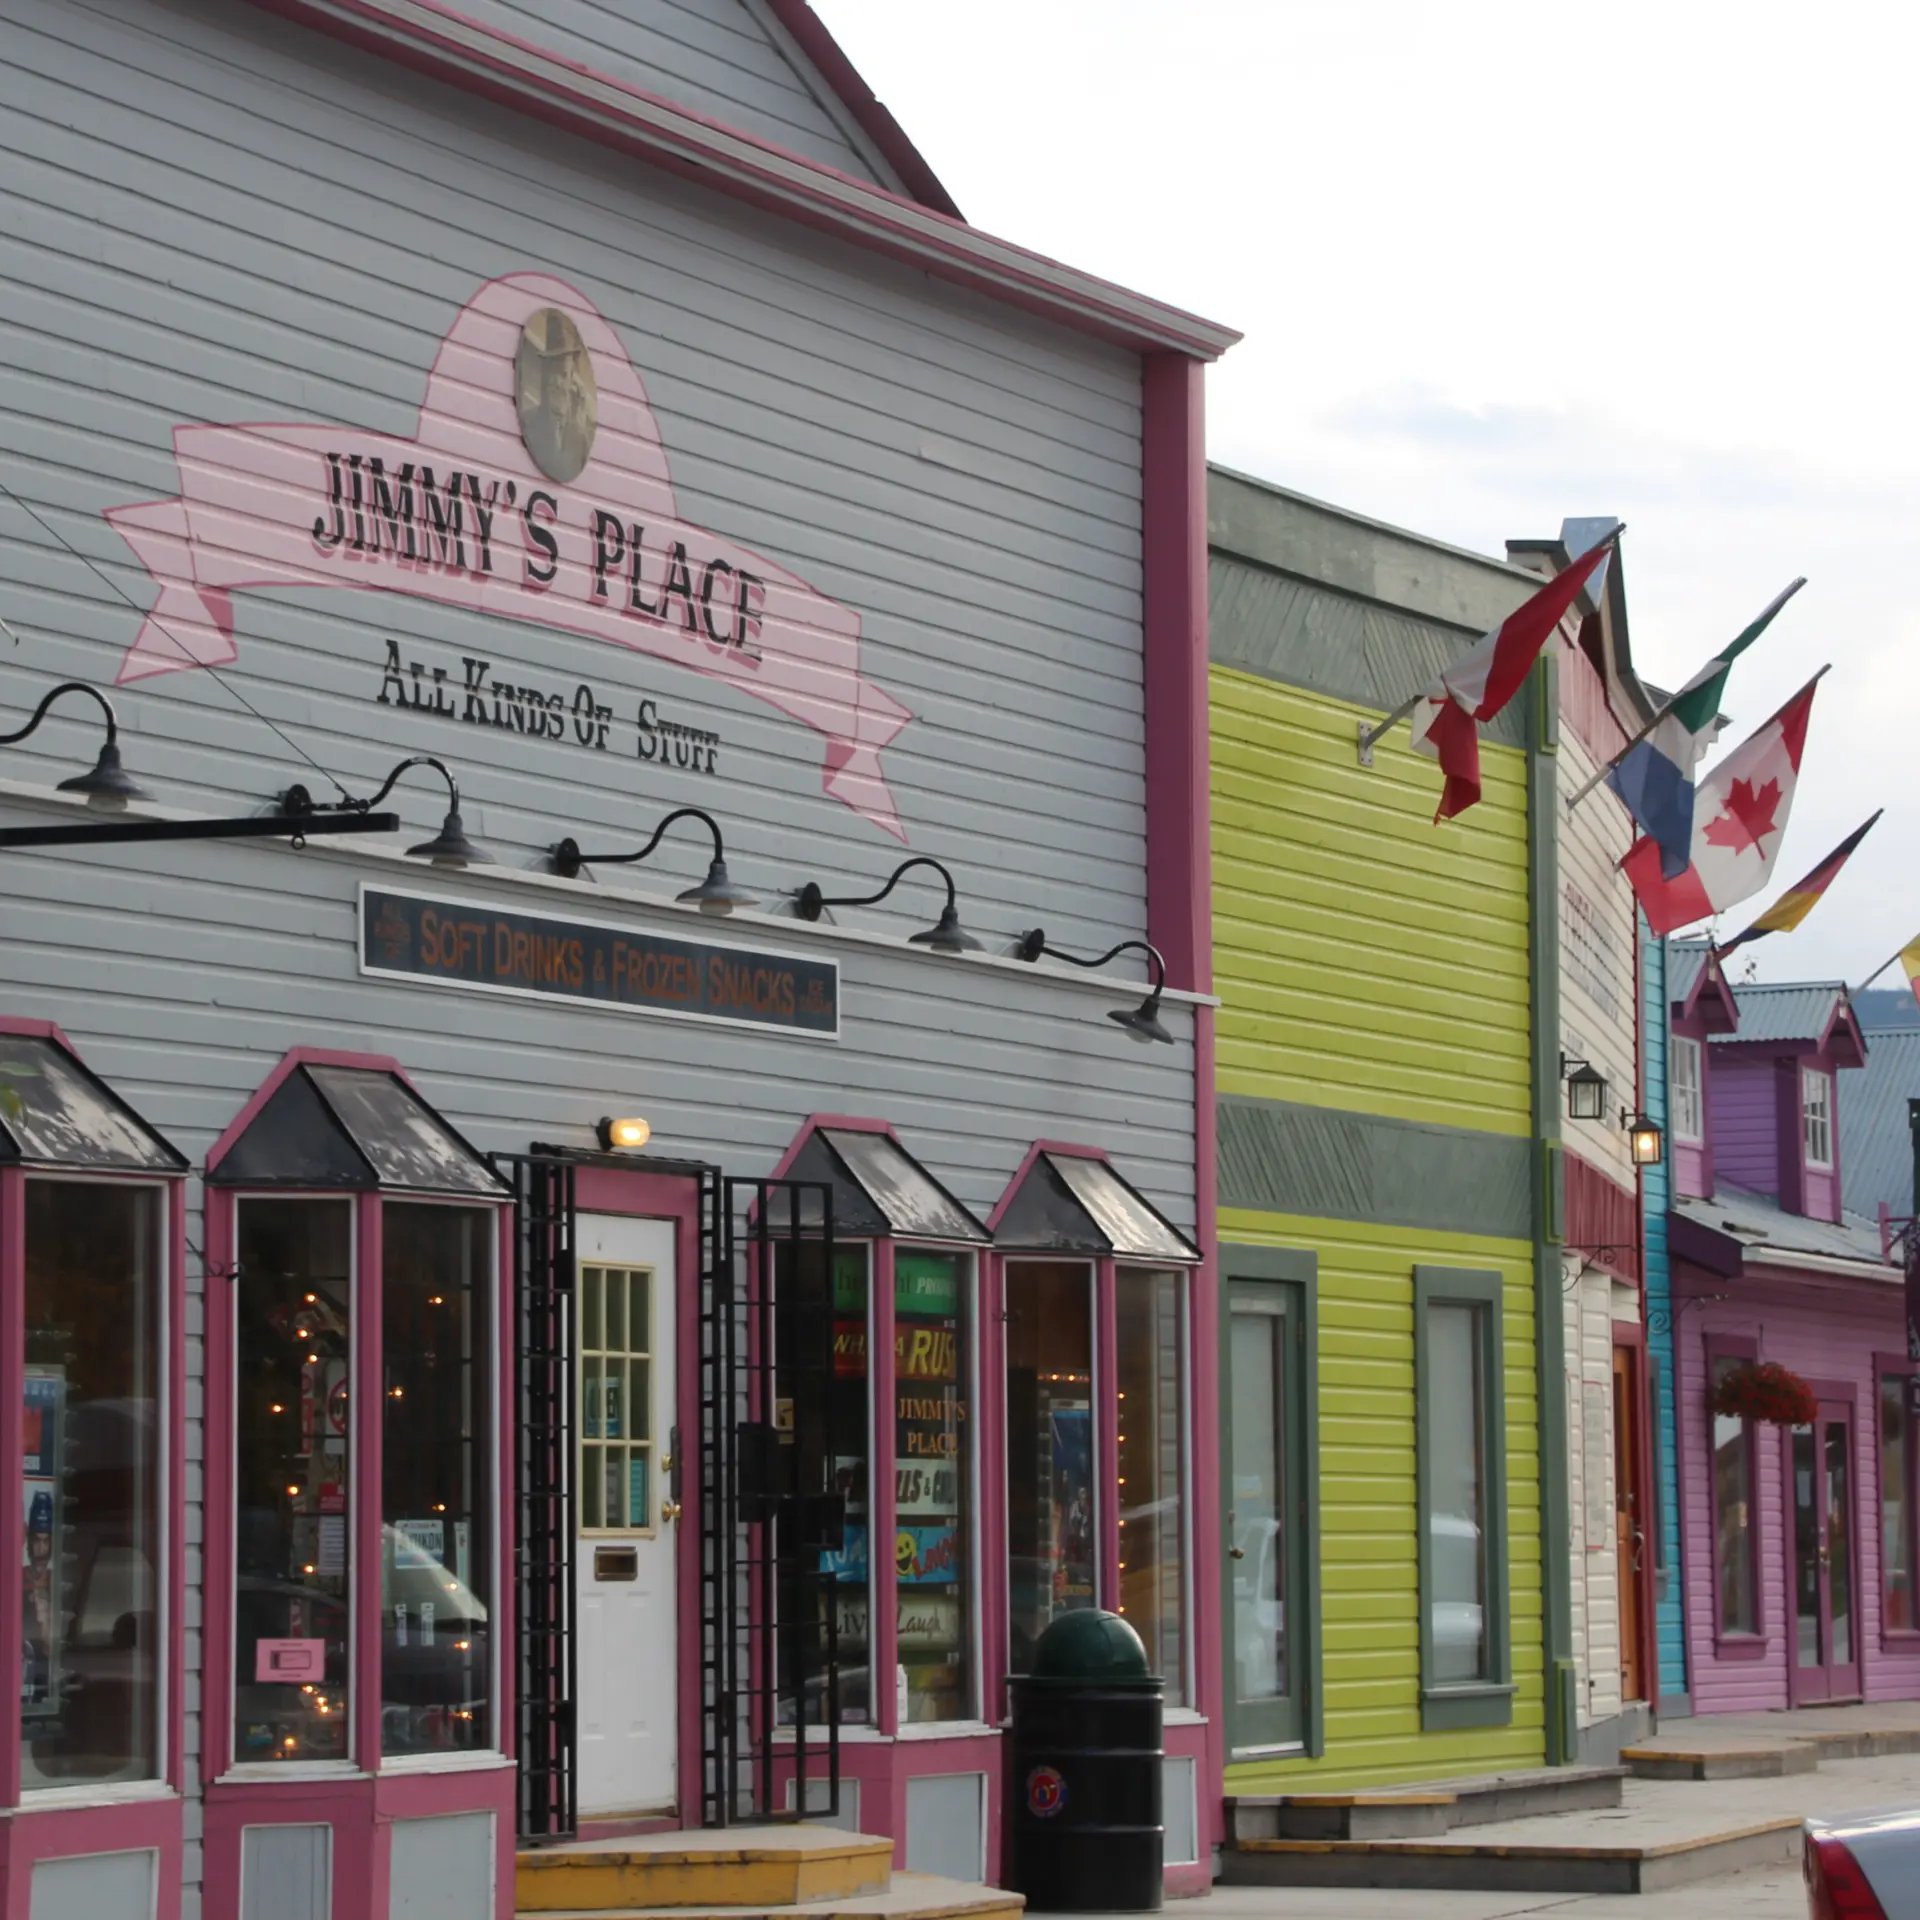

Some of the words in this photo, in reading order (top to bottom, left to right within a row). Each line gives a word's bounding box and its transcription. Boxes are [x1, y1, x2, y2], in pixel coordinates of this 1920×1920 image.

[311, 452, 558, 590] JIMMY'S
[593, 509, 766, 664] PLACE
[377, 639, 456, 719] ALL
[461, 656, 565, 739] KINDS
[573, 684, 613, 750] OF
[637, 699, 720, 774] STUFF
[421, 908, 487, 974] SOFT
[494, 922, 585, 987] DRINKS
[593, 948, 605, 982] &
[611, 940, 700, 1002] FROZEN
[708, 957, 796, 1016] SNACKS
[898, 1398, 966, 1422] JIMMY'S
[907, 1431, 959, 1455] PLACE
